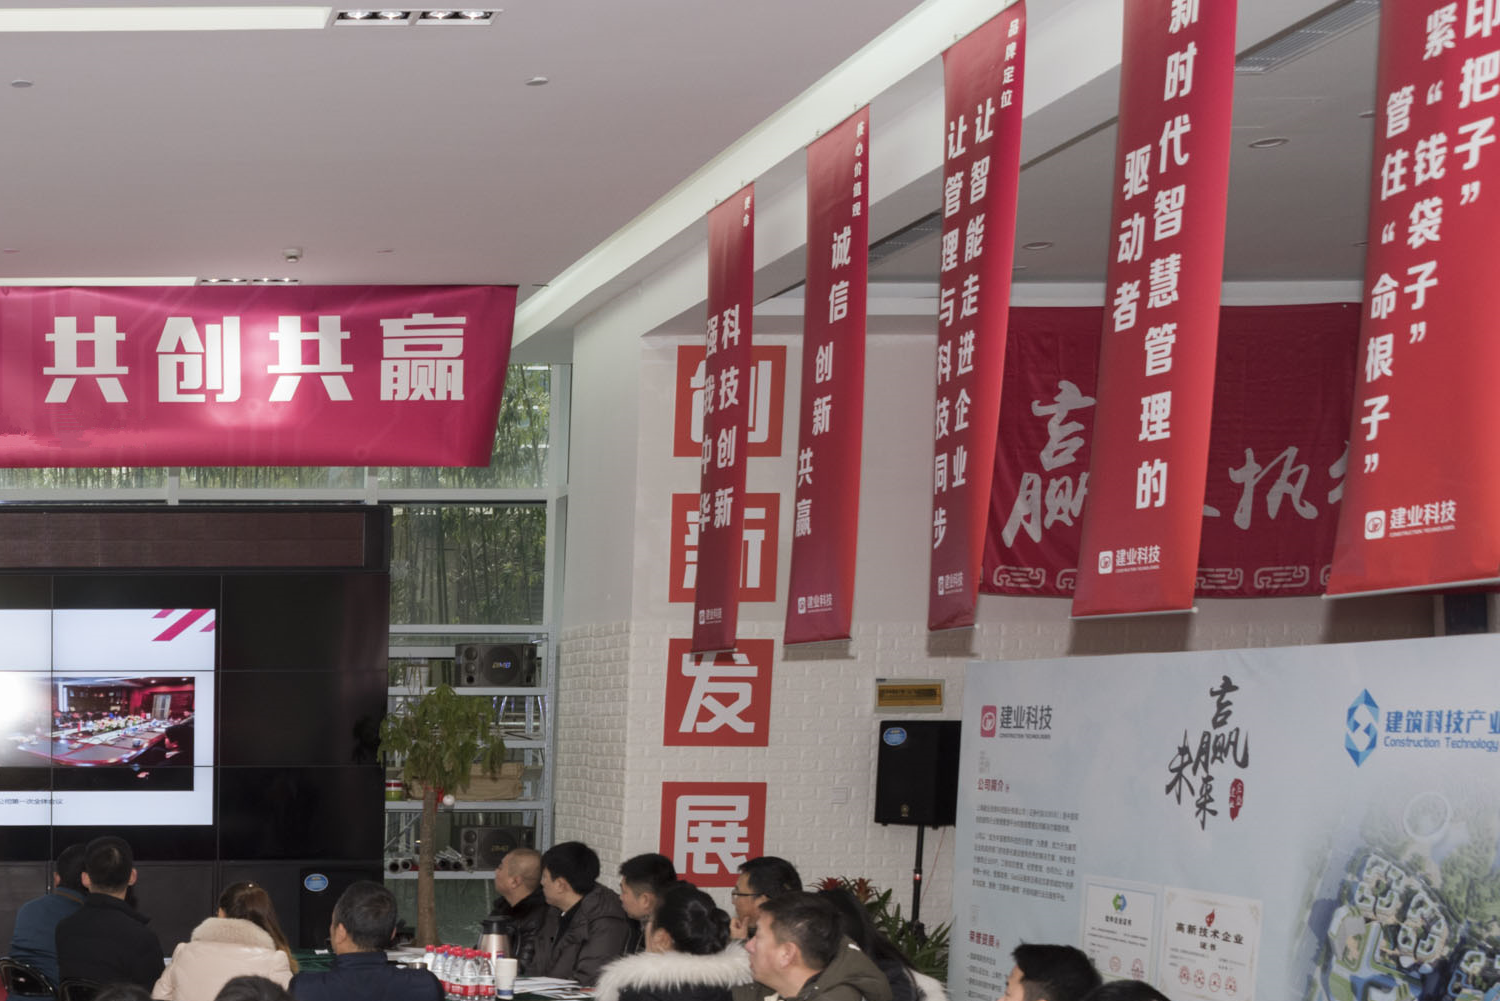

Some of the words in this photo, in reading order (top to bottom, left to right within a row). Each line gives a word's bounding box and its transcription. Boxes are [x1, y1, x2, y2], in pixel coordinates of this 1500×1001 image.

[1112, 143, 1152, 333] 驱动者
[952, 97, 995, 488] 让智能走进企业
[42, 313, 467, 403] 共创共赢
[934, 114, 967, 549] 让管理与科技同步
[713, 304, 741, 528] 科技创新
[1389, 500, 1457, 530] 建业科技
[1115, 545, 1161, 567] 建业科技
[999, 705, 1053, 730] 建业科技
[1383, 736, 1441, 748] Construction
[1445, 737, 1499, 752] Technology
[1175, 922, 1244, 945] 高新技术企业
